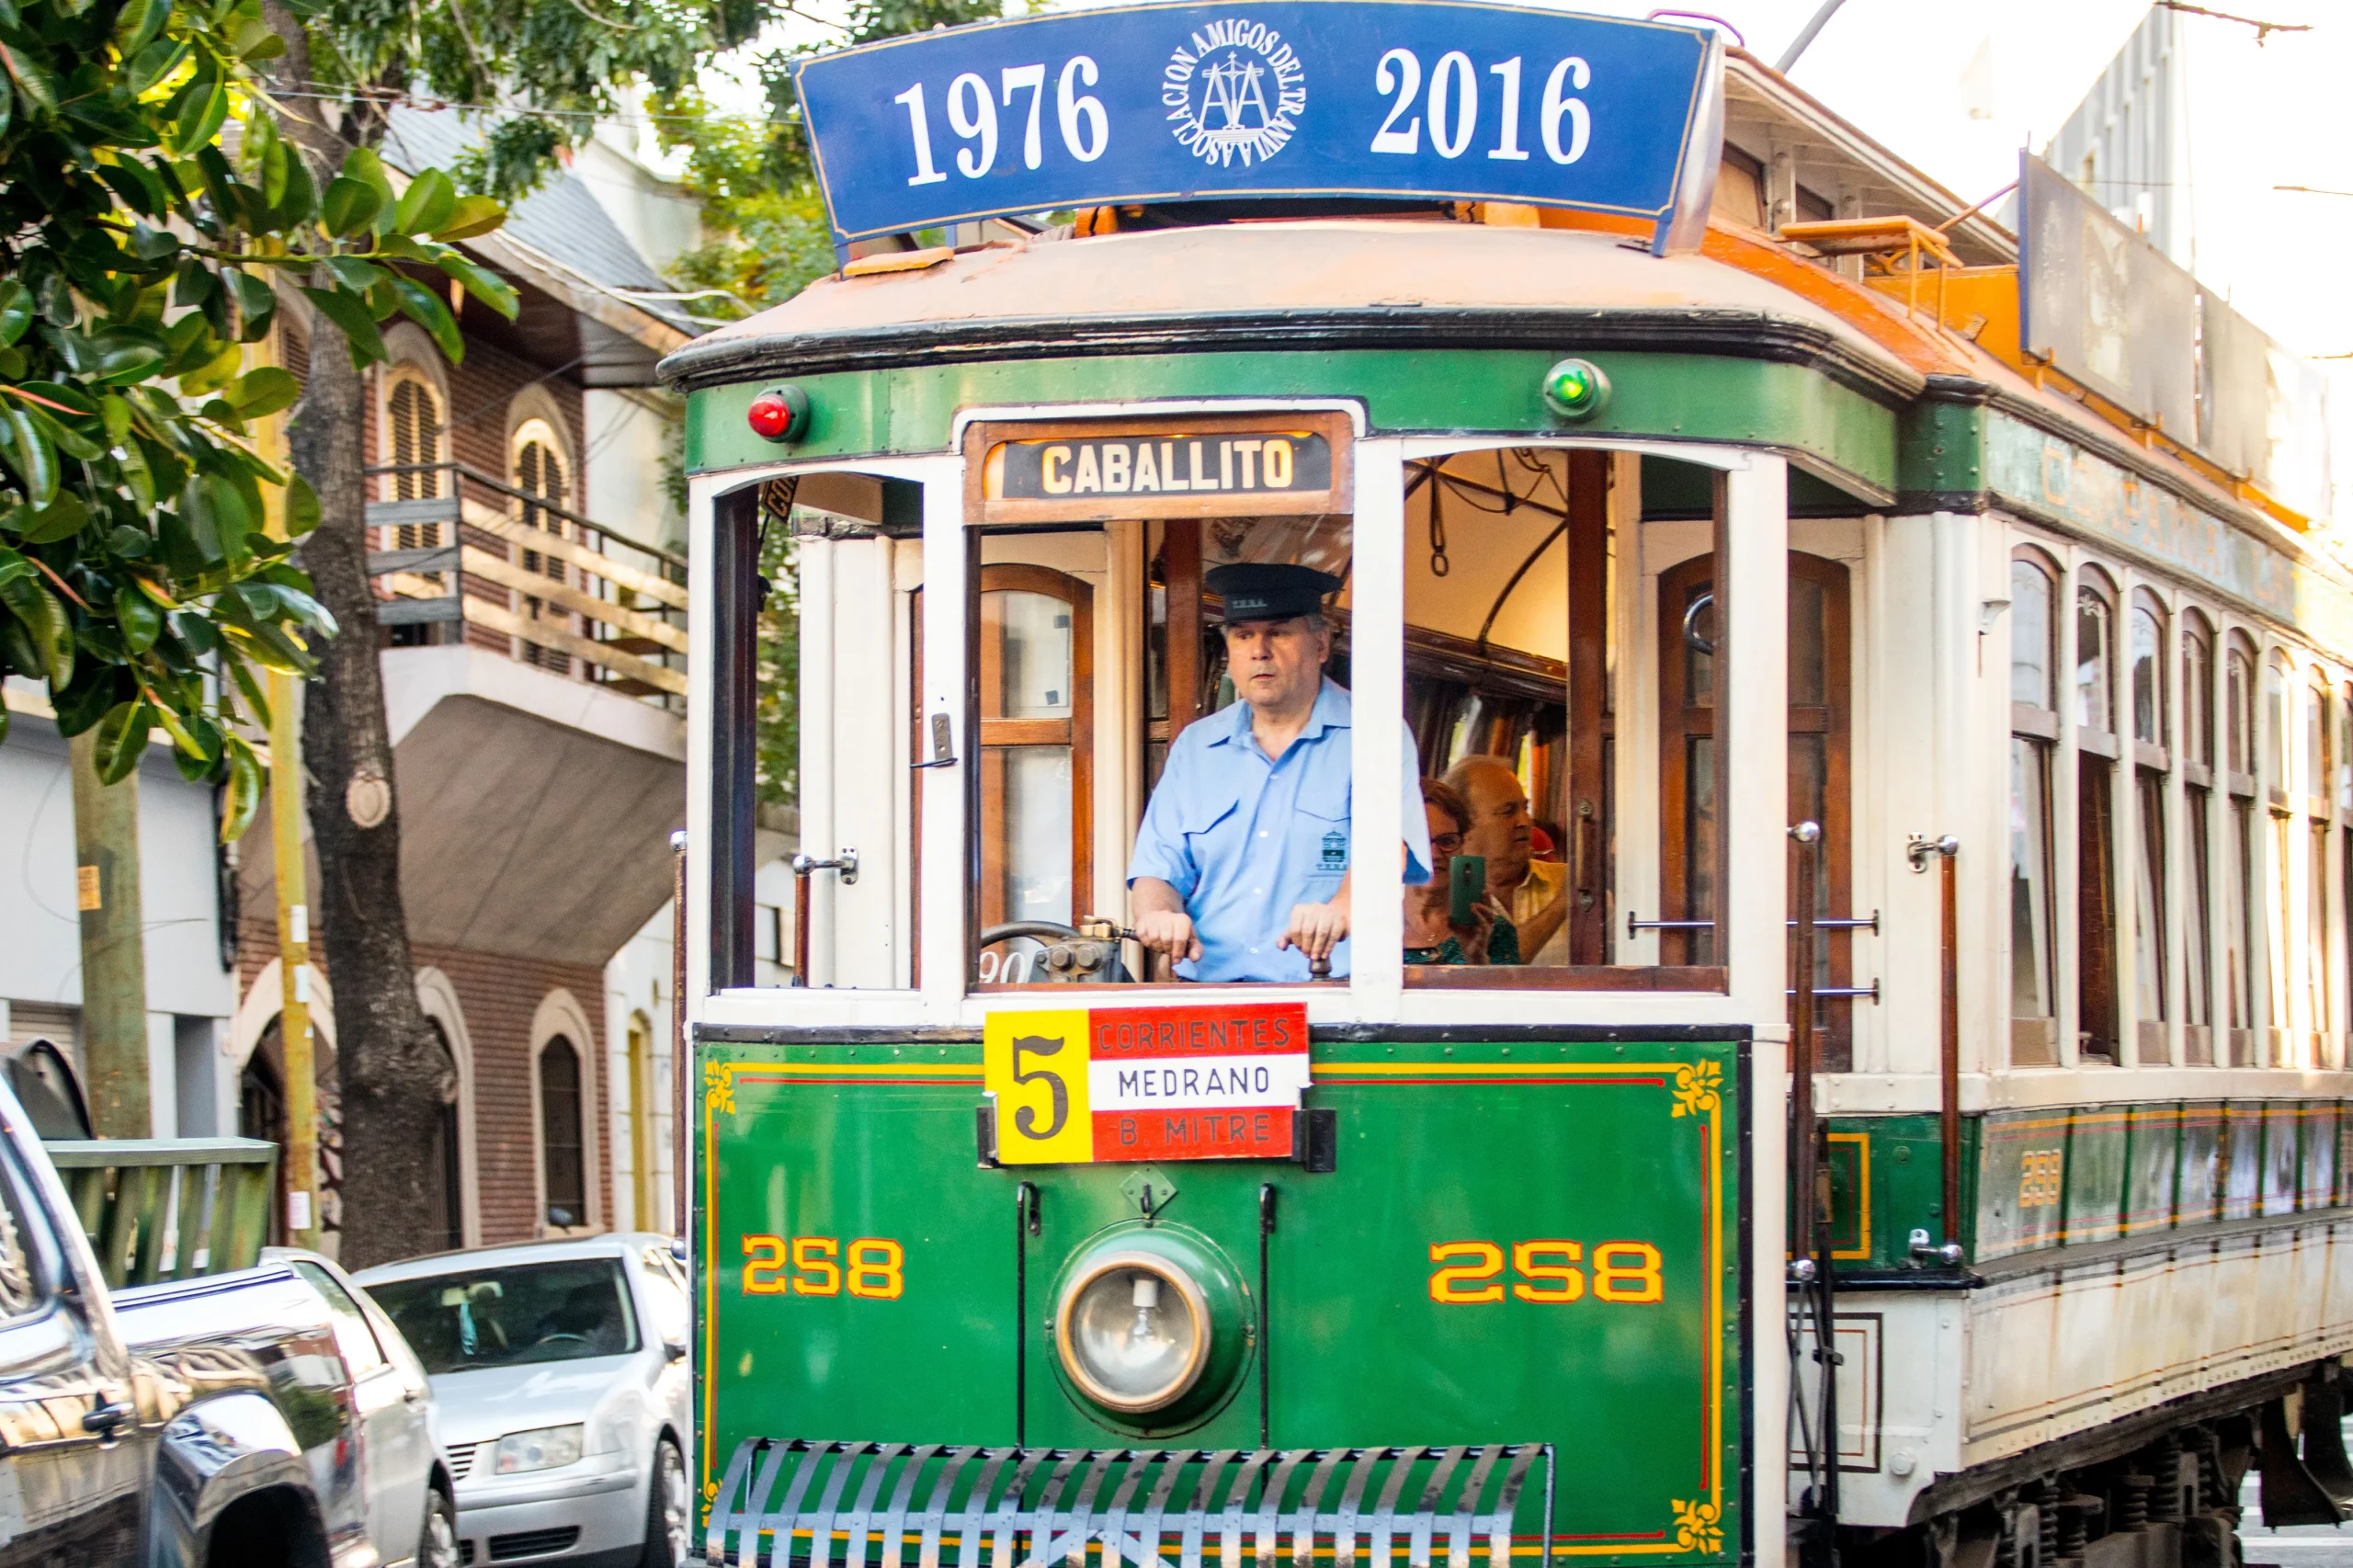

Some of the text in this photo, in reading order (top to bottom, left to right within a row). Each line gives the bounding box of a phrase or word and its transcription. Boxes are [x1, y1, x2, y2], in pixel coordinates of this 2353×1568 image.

[893, 55, 1108, 187] 1976
[1162, 18, 1307, 168] ASOCIACION AMIGOS DEL TRANVIA
[1370, 48, 1592, 165] 2016
[1042, 439, 1293, 494] CABALLITO
[1098, 1018, 1290, 1051] CORRIENTES
[1013, 1035, 1069, 1141] 5
[1119, 1066, 1269, 1097] MEDRANO
[1120, 1114, 1270, 1146] B. MITRE
[741, 1233, 905, 1301] 258
[1428, 1239, 1665, 1306] 258
